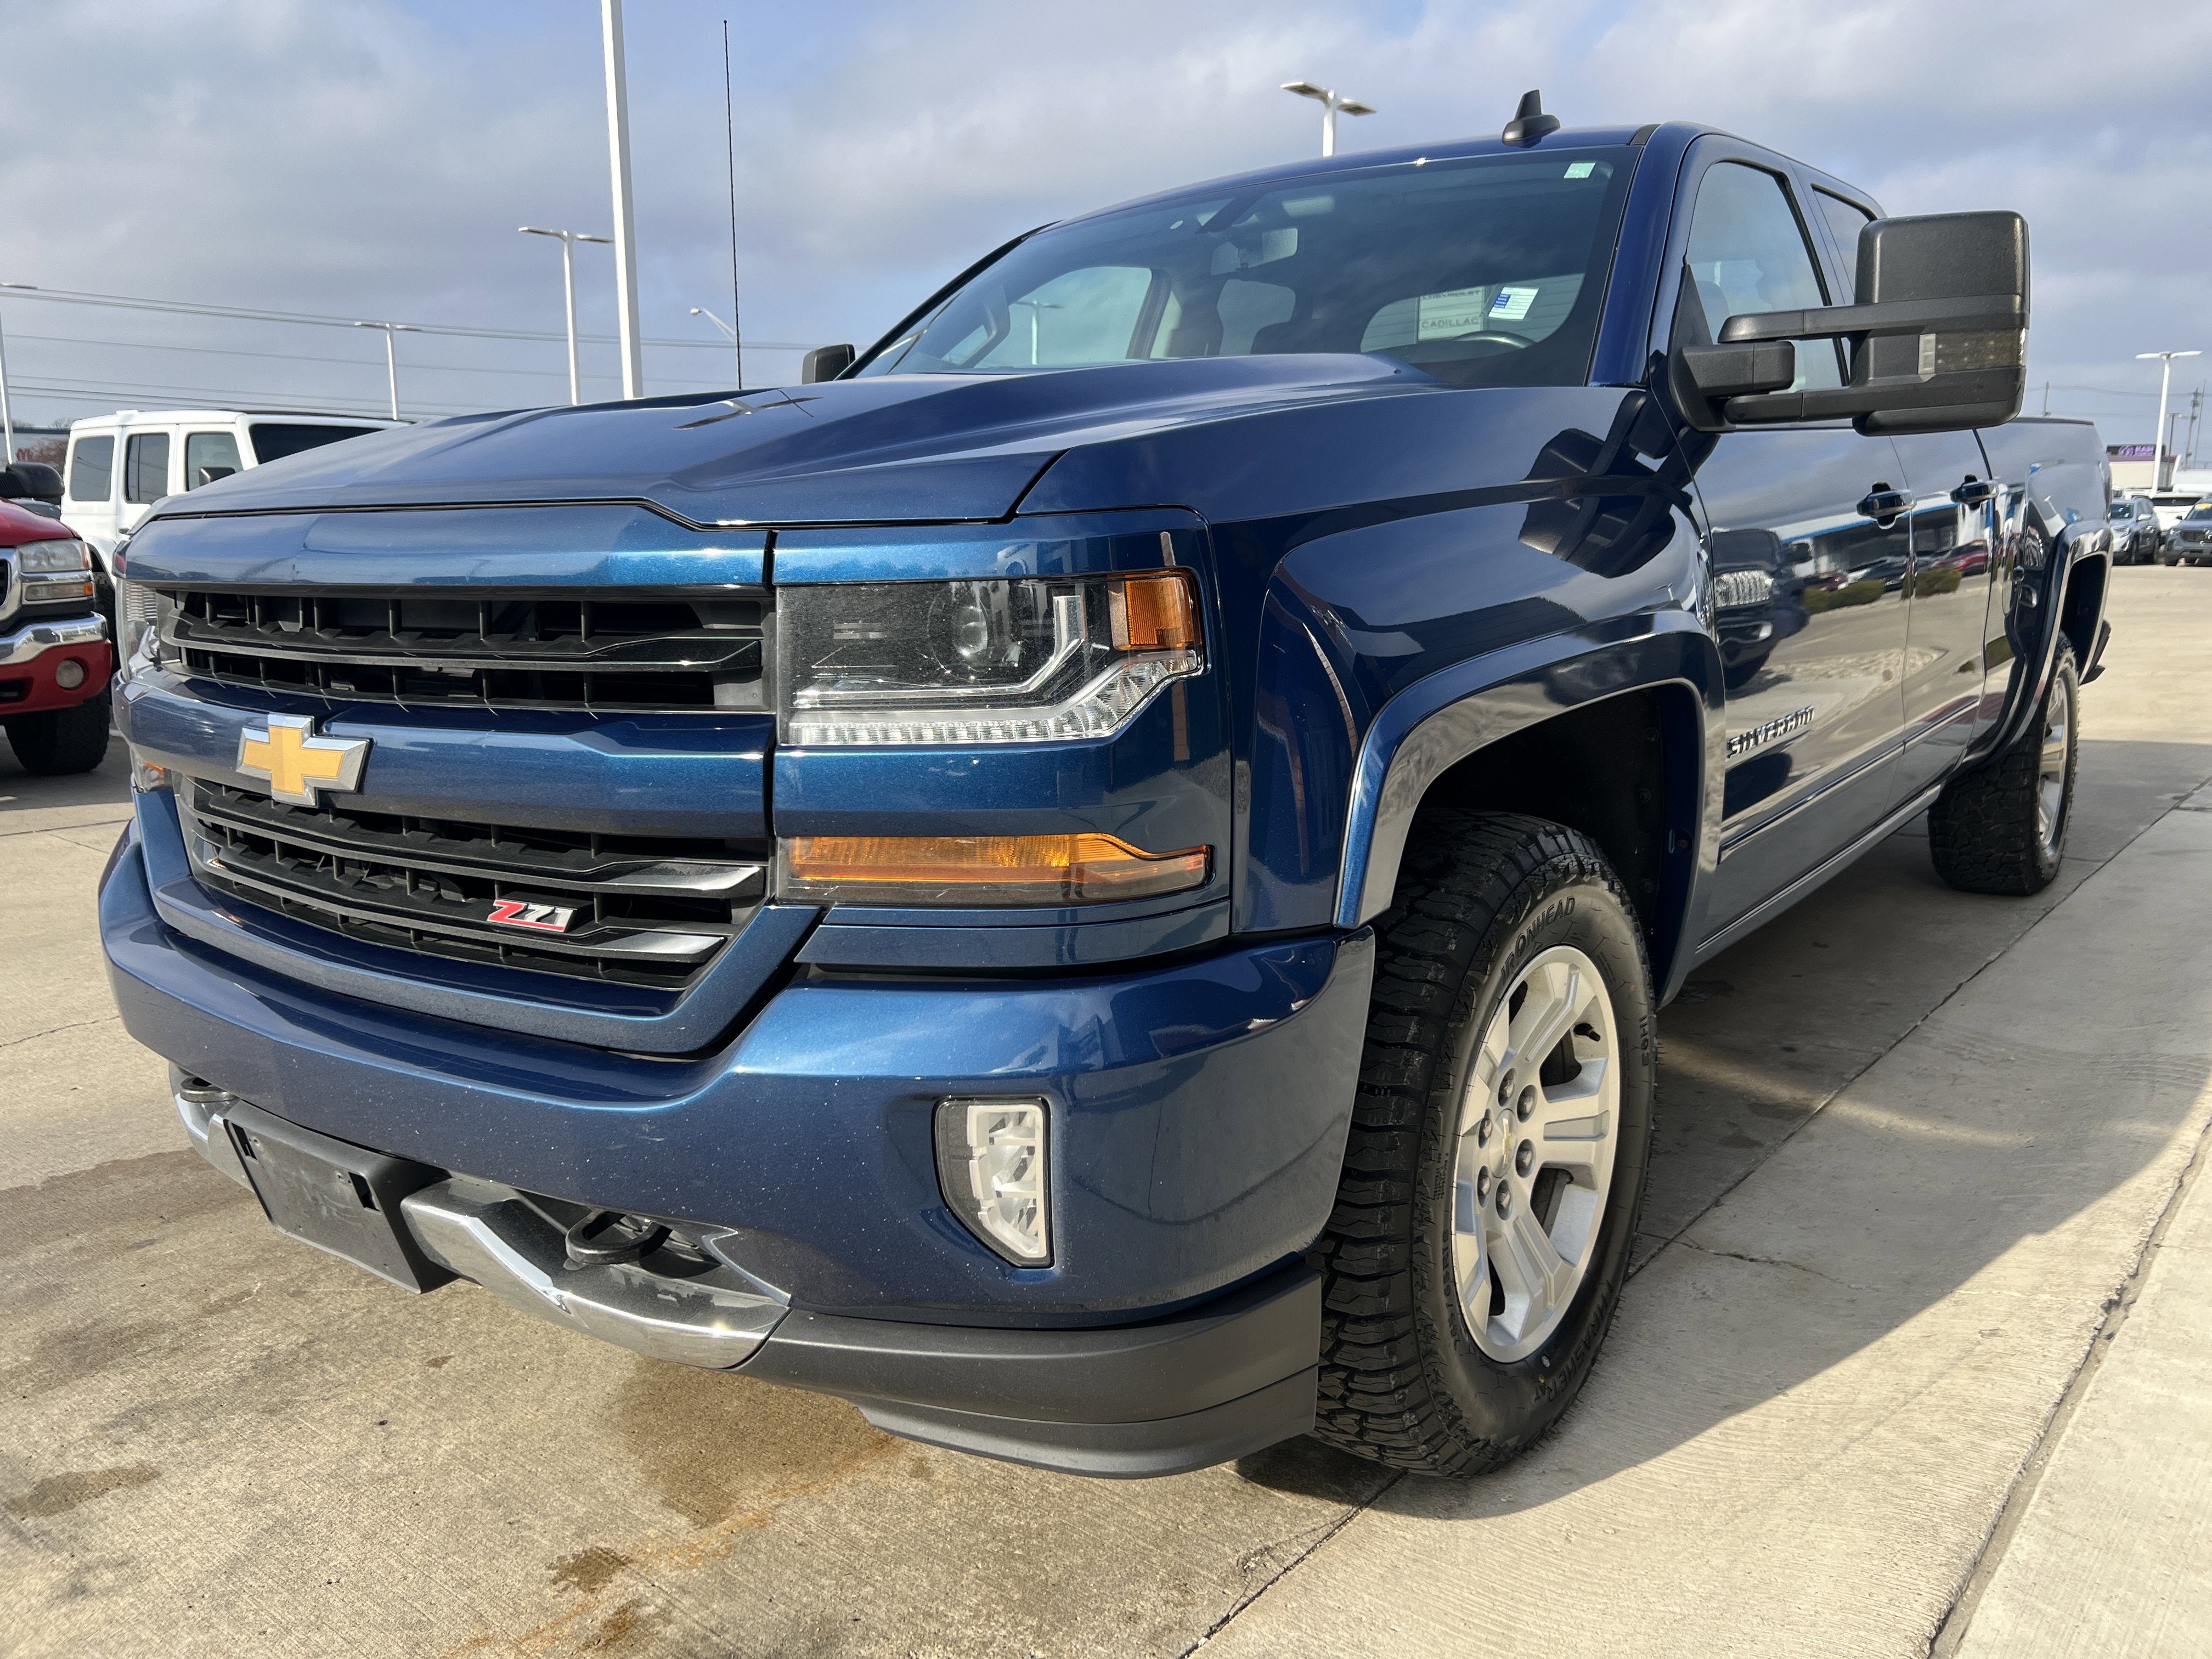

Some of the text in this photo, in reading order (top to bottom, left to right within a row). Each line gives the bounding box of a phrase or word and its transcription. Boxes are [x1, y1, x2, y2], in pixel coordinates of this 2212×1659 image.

[1421, 317, 1480, 329] CADILLAC
[487, 899, 574, 933] Z71
[1500, 895, 1575, 986] IRONHEAD
